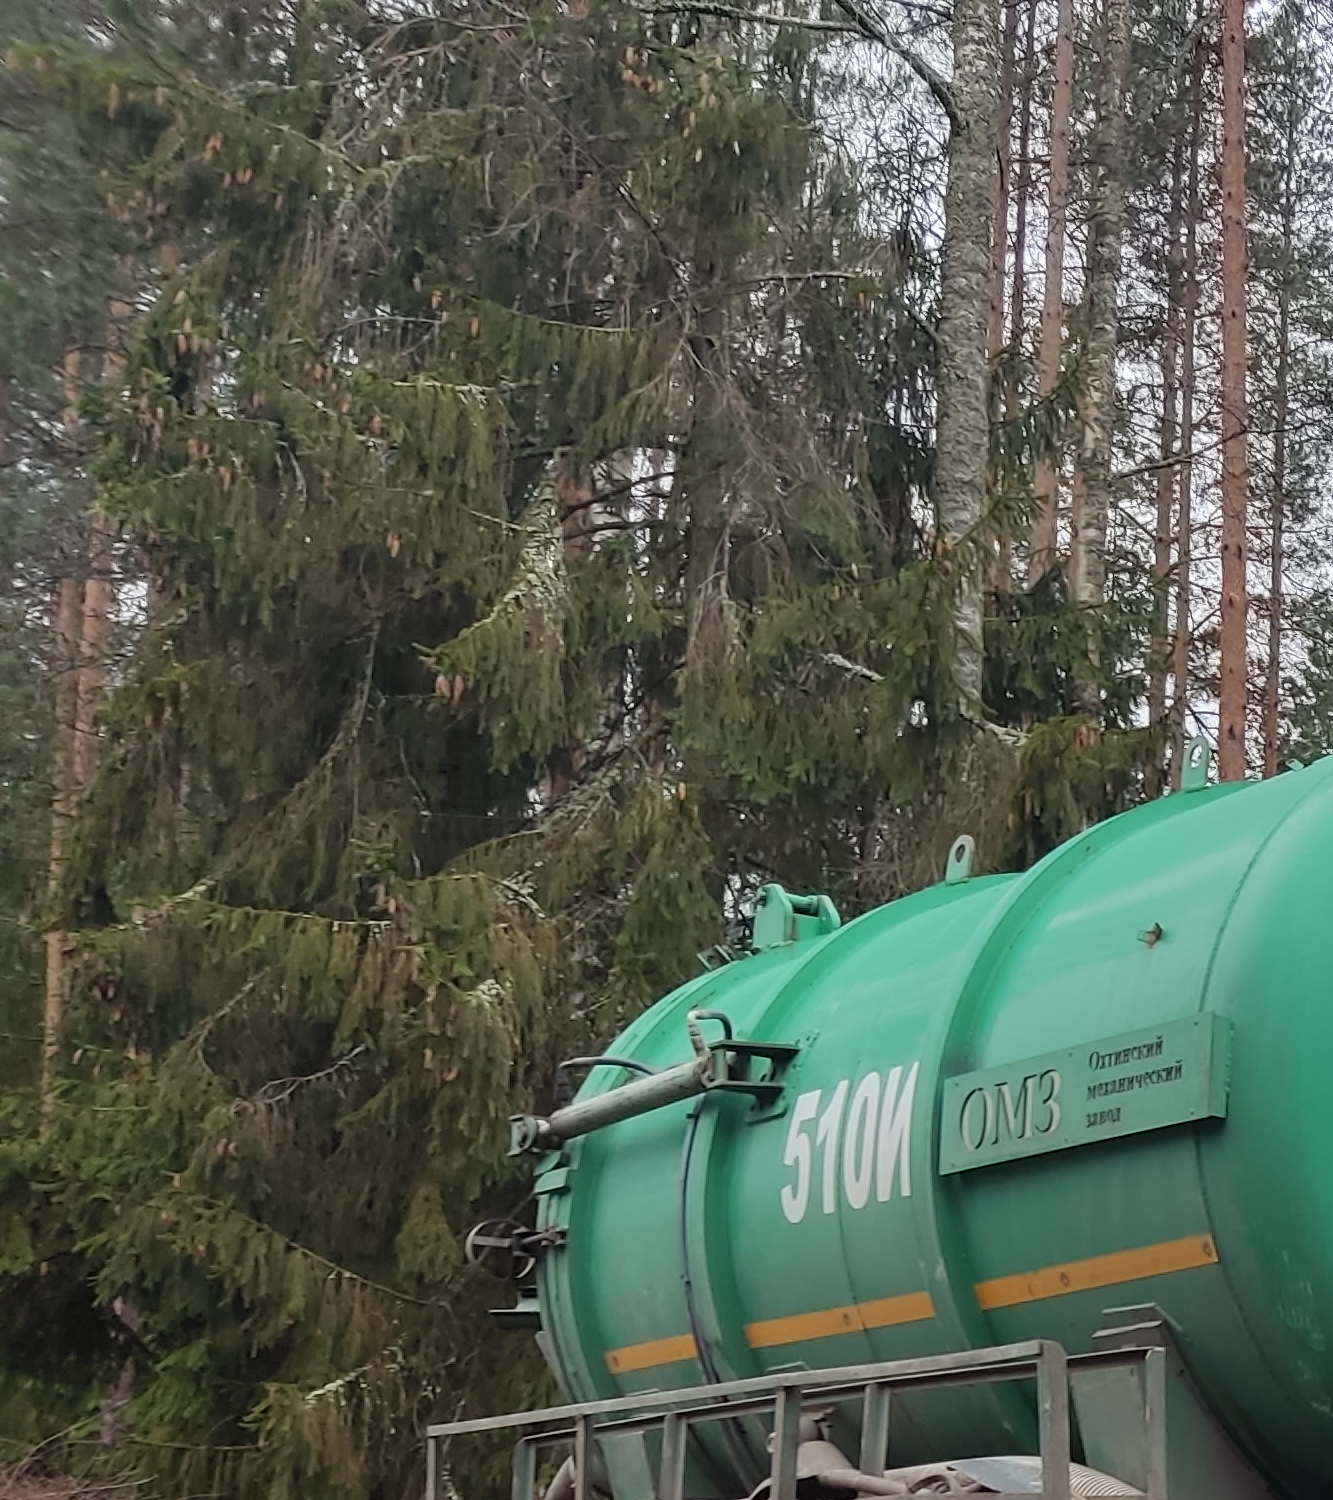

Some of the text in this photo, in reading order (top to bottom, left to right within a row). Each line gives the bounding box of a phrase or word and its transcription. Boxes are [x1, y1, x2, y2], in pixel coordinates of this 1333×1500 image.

[1088, 1035, 1163, 1071] Охтинский
[1086, 1060, 1183, 1101] механический
[960, 1068, 1061, 1151] ОМЗ
[1085, 1107, 1122, 1129] завод
